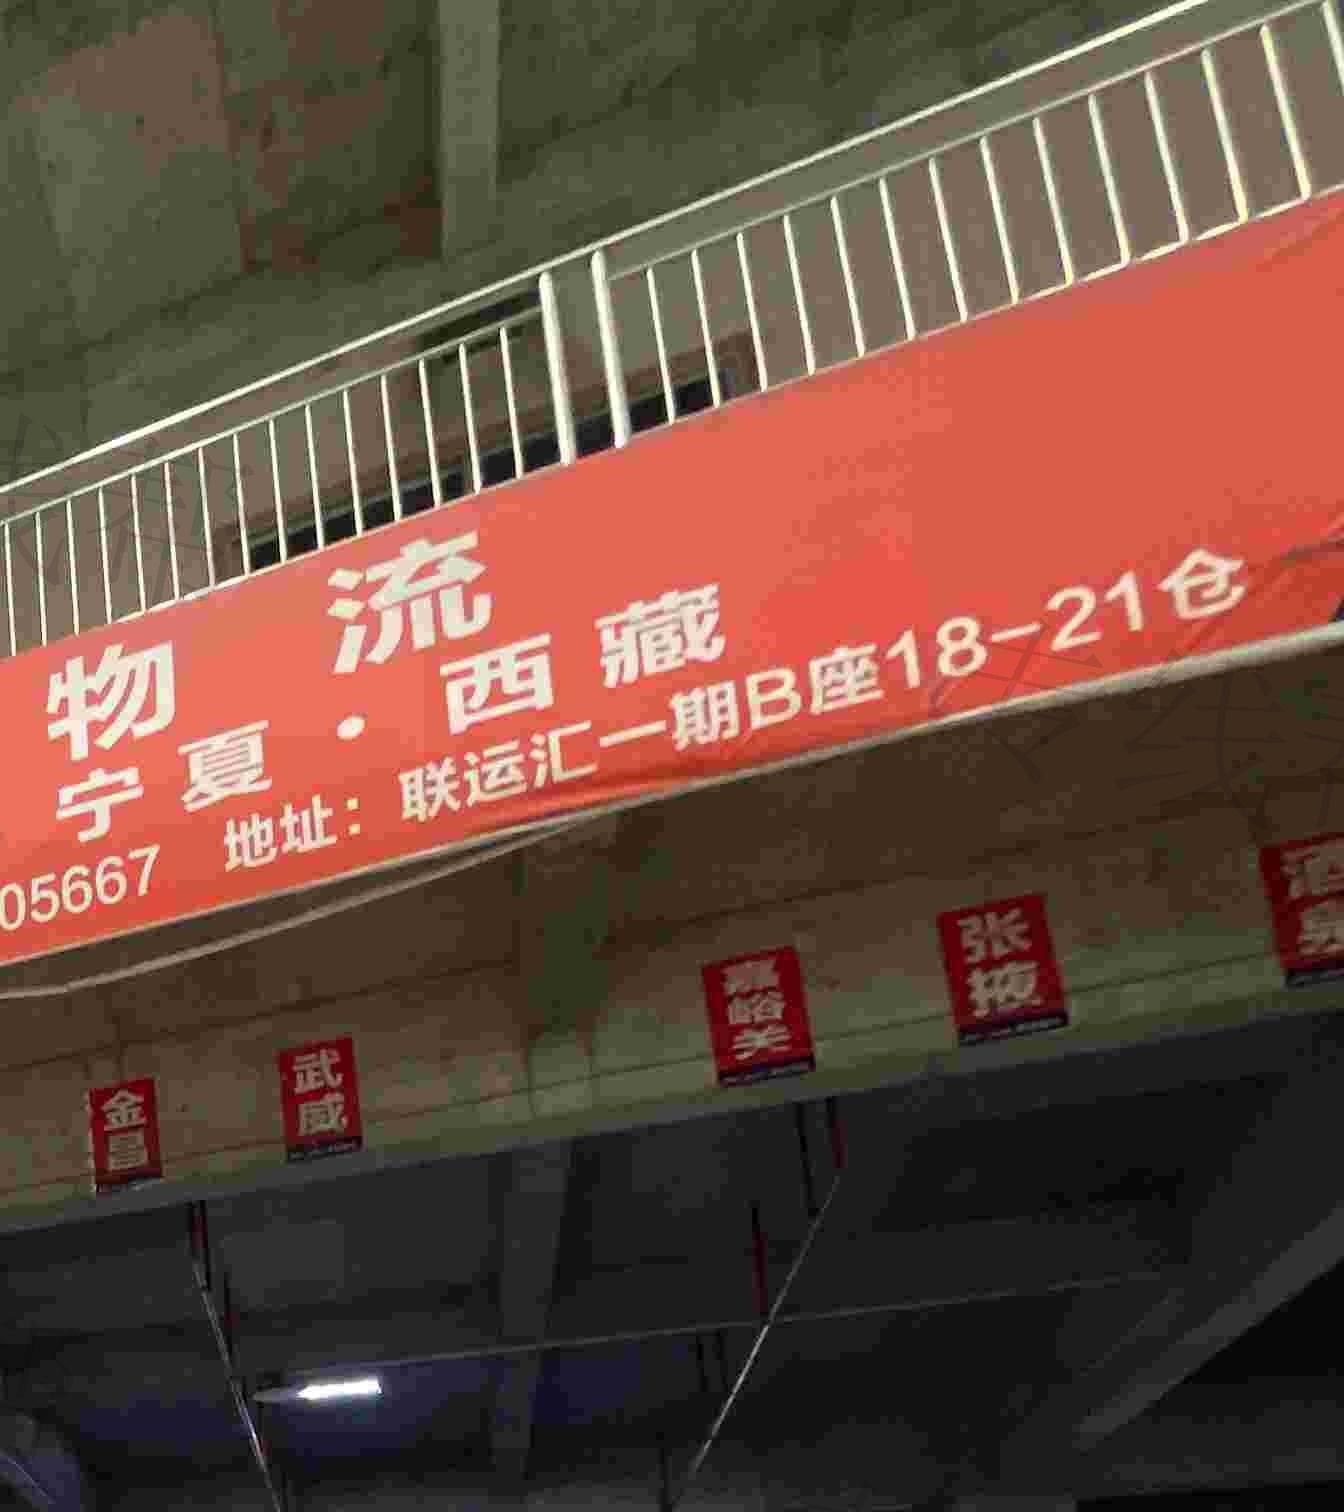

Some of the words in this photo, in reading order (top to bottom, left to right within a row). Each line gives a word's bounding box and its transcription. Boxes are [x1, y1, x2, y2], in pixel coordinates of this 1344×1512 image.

[722, 960, 793, 1060] 嘉峪关
[958, 908, 1046, 1018] 张掖
[100, 1086, 150, 1172] 金昌
[291, 1049, 349, 1140] 武威
